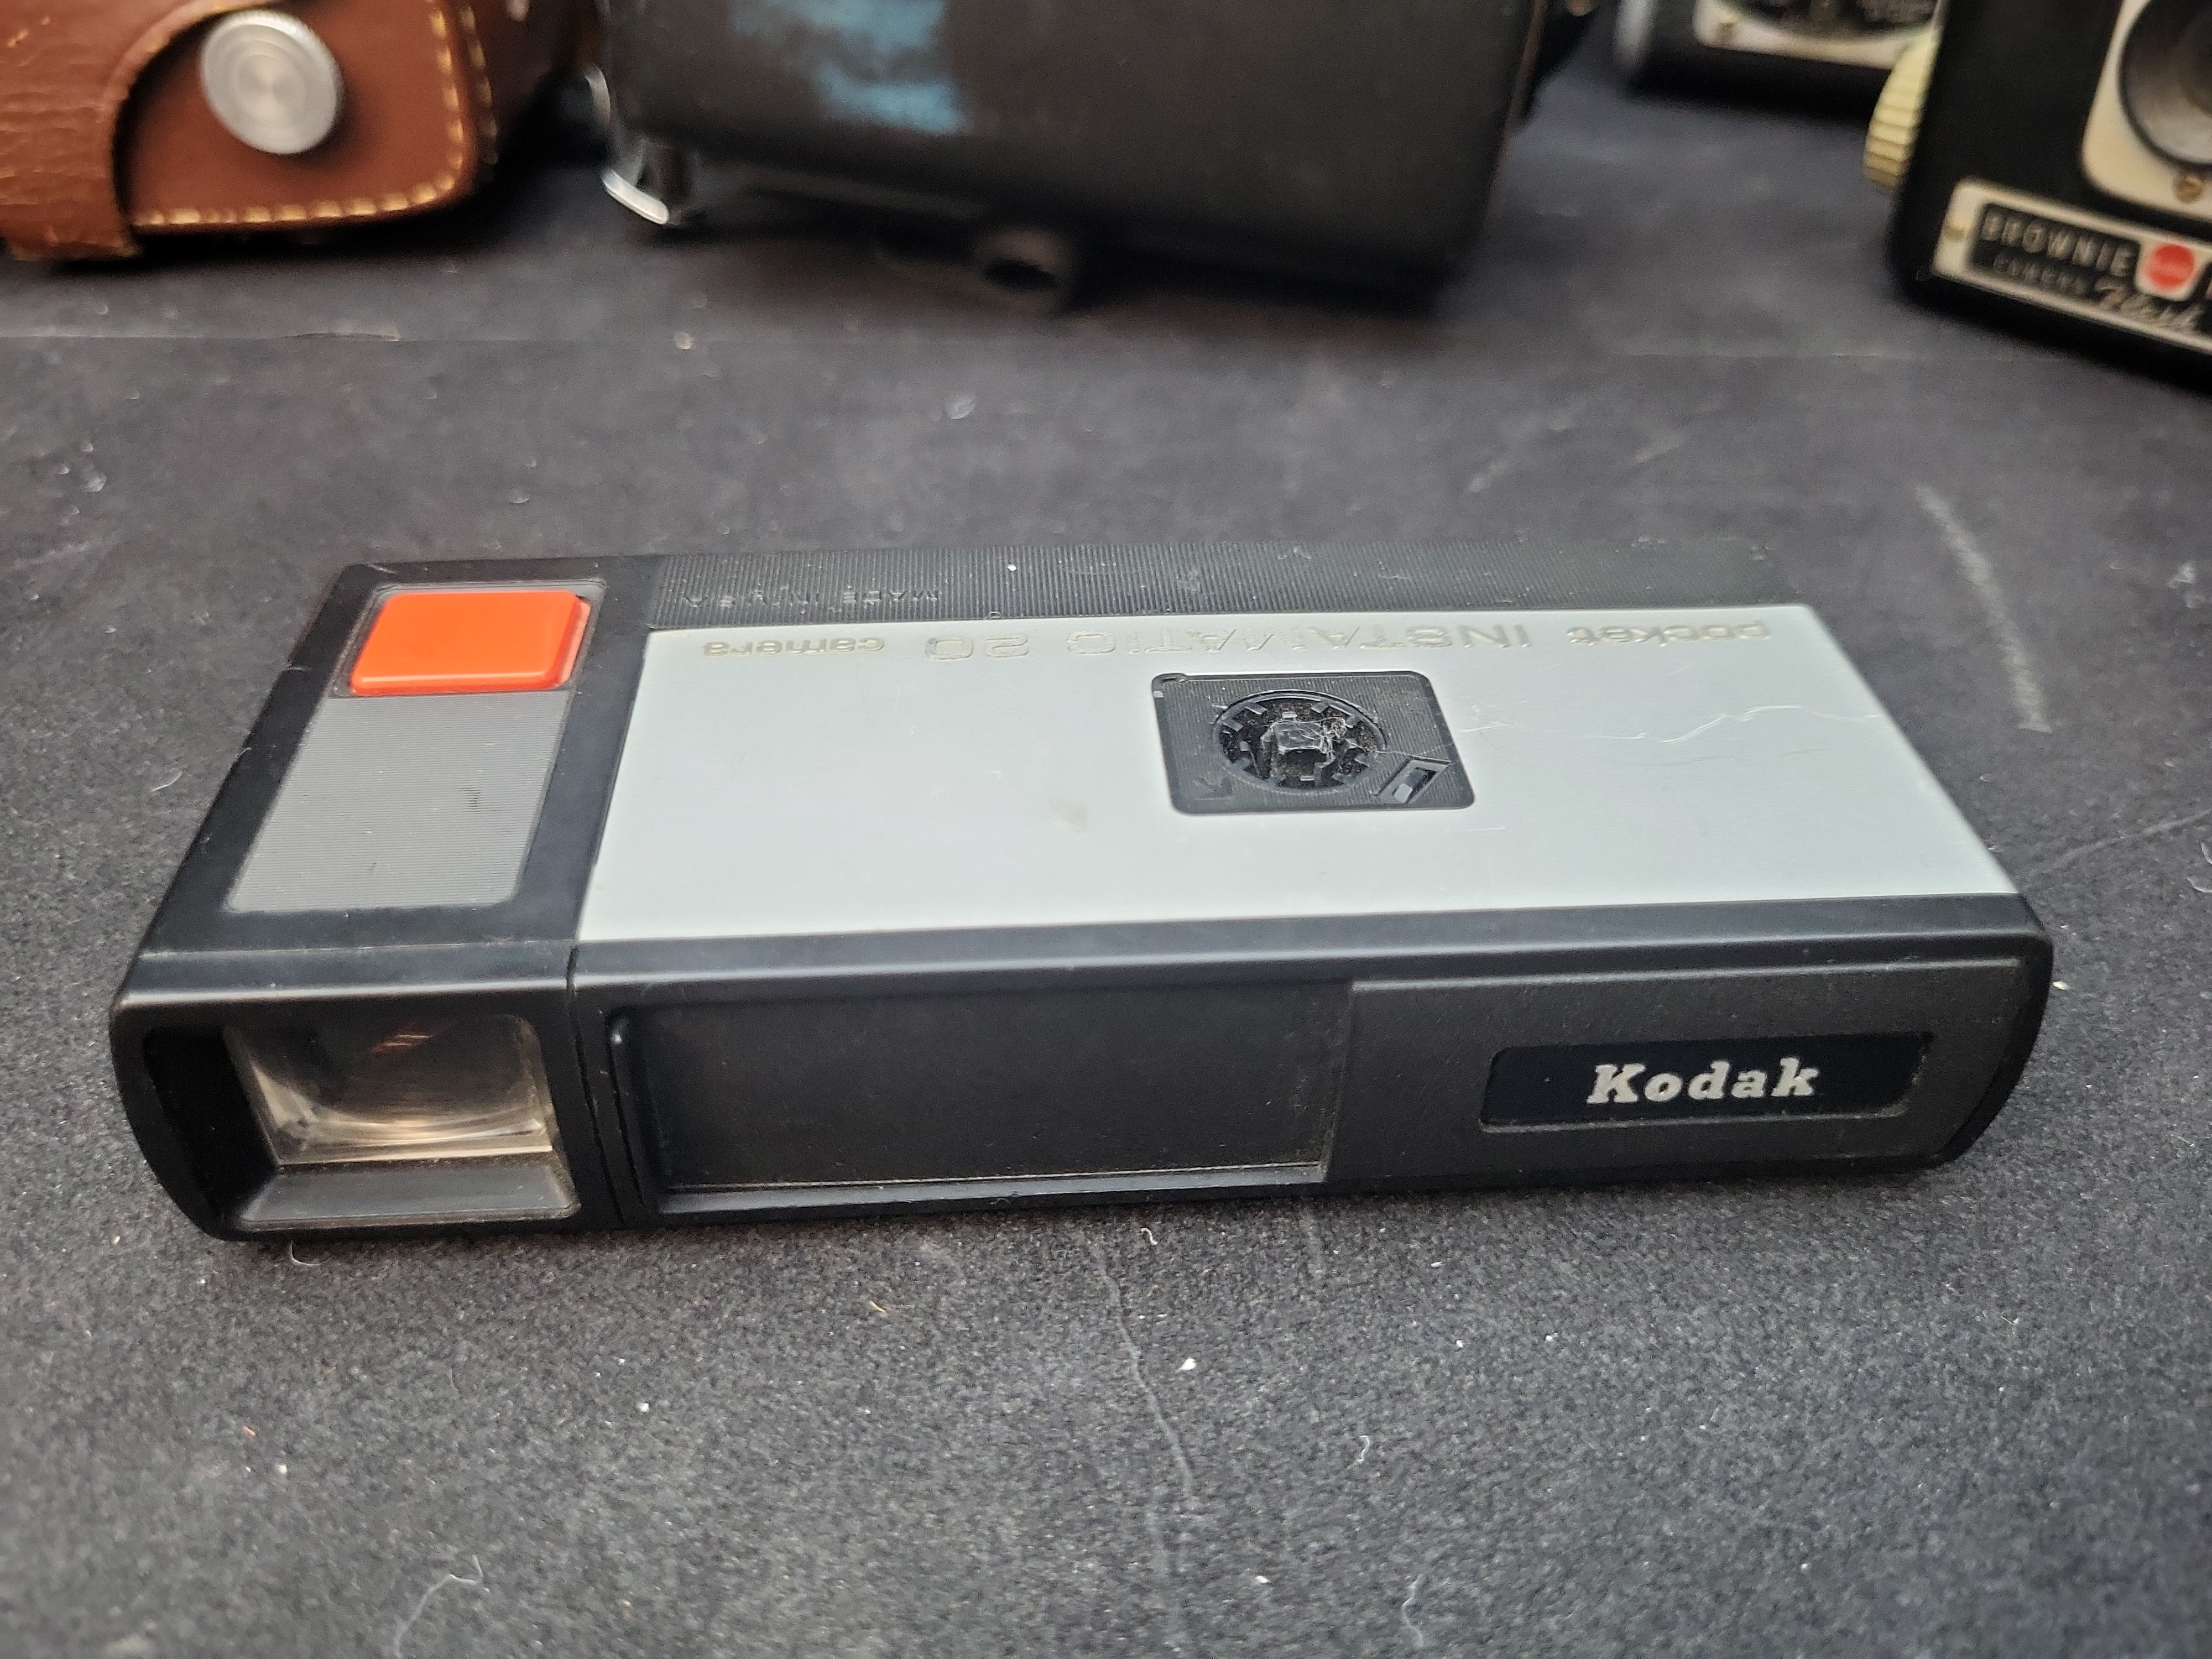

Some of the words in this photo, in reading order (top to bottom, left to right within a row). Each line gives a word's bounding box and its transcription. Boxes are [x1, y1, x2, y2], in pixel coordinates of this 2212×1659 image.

[1981, 212, 2139, 277] BROWNIE
[842, 588, 941, 605] MADE
[703, 637, 885, 657] camera
[925, 633, 1029, 660] 20
[1067, 624, 1531, 655] INSTAMATIC
[1566, 620, 1770, 647] pocket
[1587, 1056, 1819, 1104] Kodak
